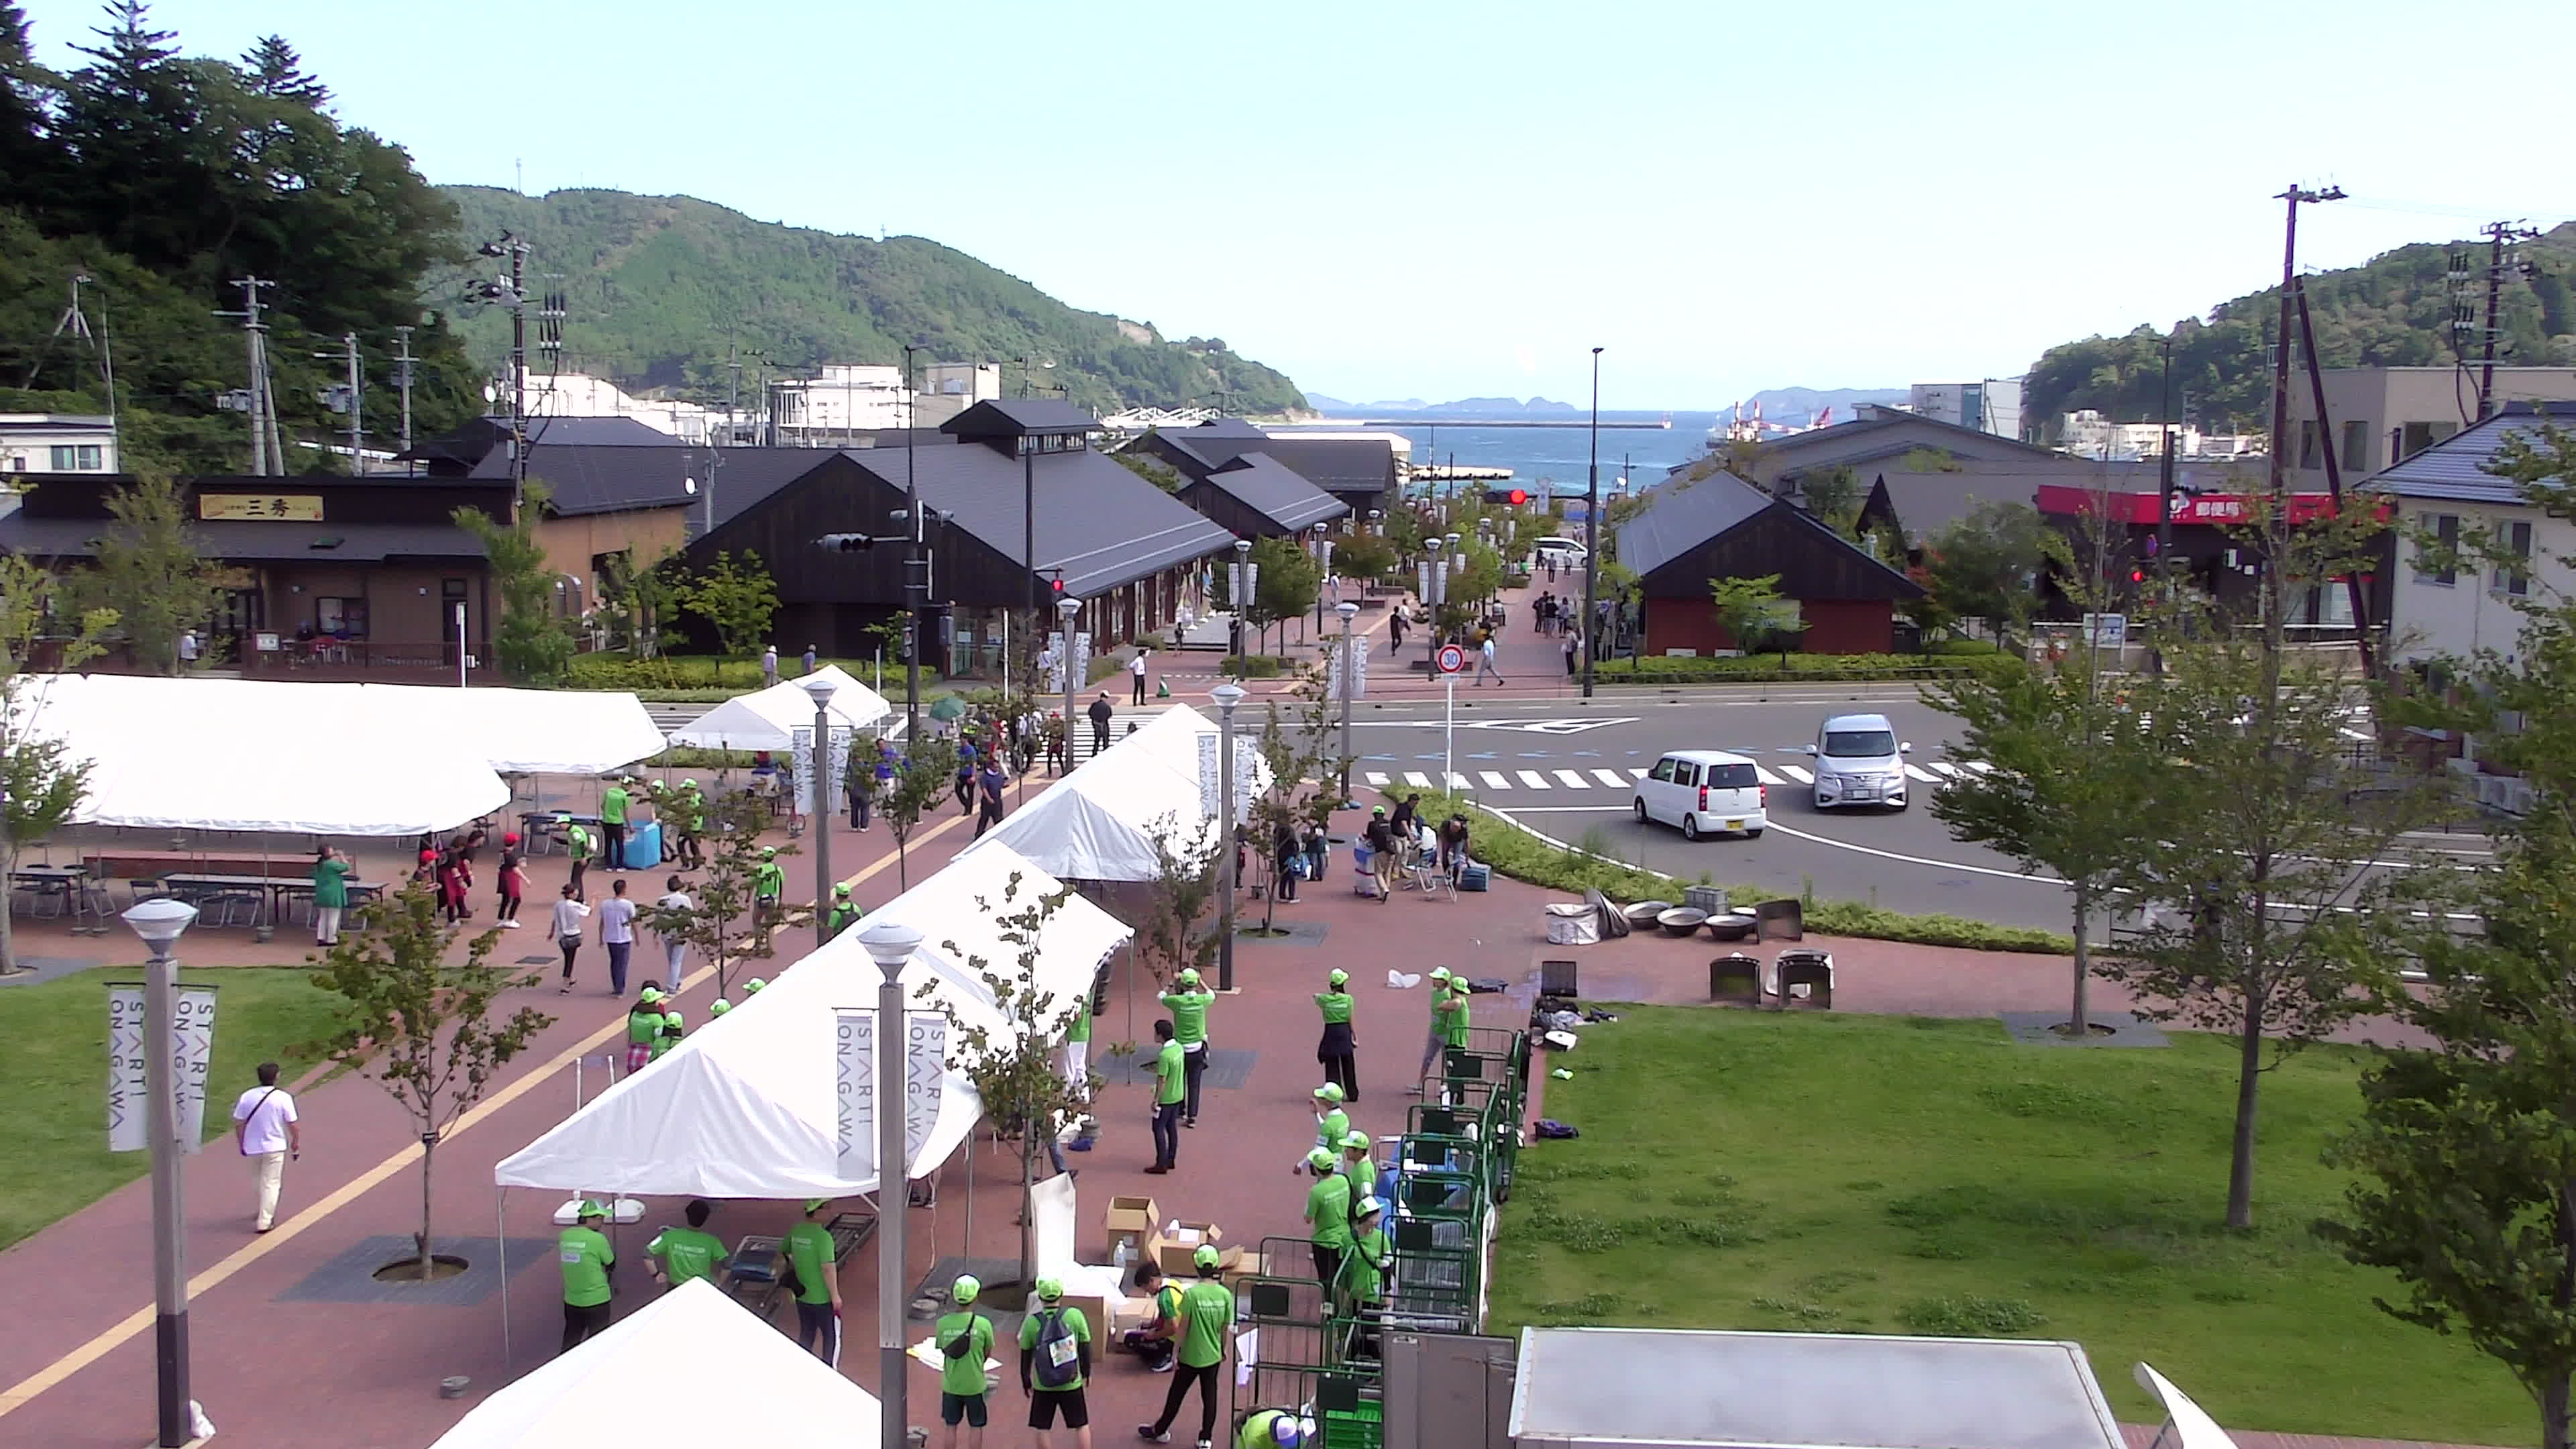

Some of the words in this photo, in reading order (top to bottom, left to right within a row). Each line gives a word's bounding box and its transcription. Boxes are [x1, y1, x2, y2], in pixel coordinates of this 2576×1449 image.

[246, 498, 290, 517] 三秀
[1444, 653, 1458, 666] 30
[109, 1000, 125, 1130] ONAGAWA
[189, 1003, 214, 1102] START!
[837, 1025, 853, 1158] ONAGAWA
[906, 1027, 925, 1154] ONAGAWA
